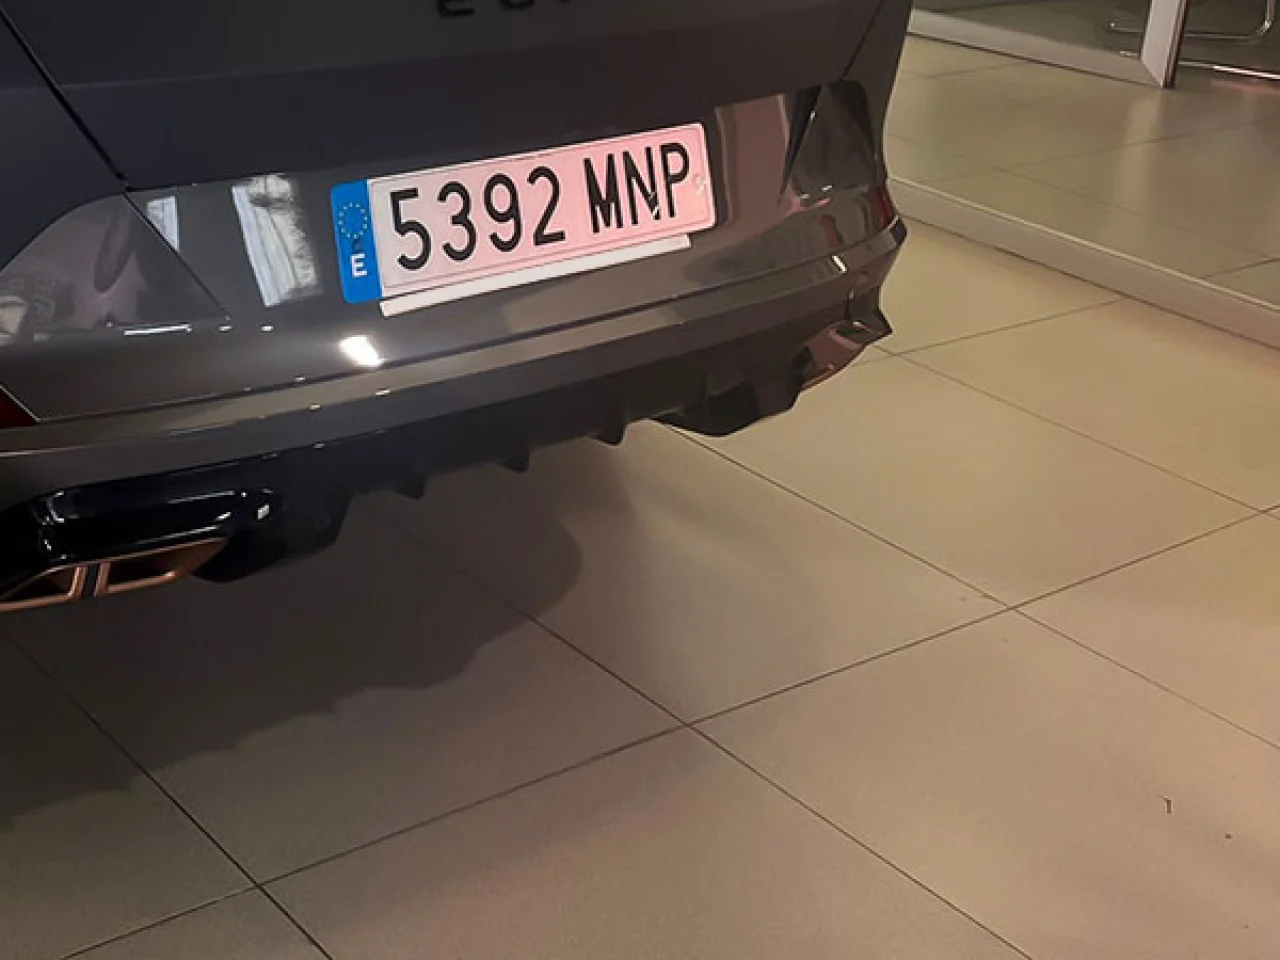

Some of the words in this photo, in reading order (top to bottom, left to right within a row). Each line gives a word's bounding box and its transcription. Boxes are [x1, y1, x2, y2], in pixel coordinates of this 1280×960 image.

[390, 166, 566, 270] 5392
[584, 142, 690, 234] MNP
[350, 253, 368, 277] E
